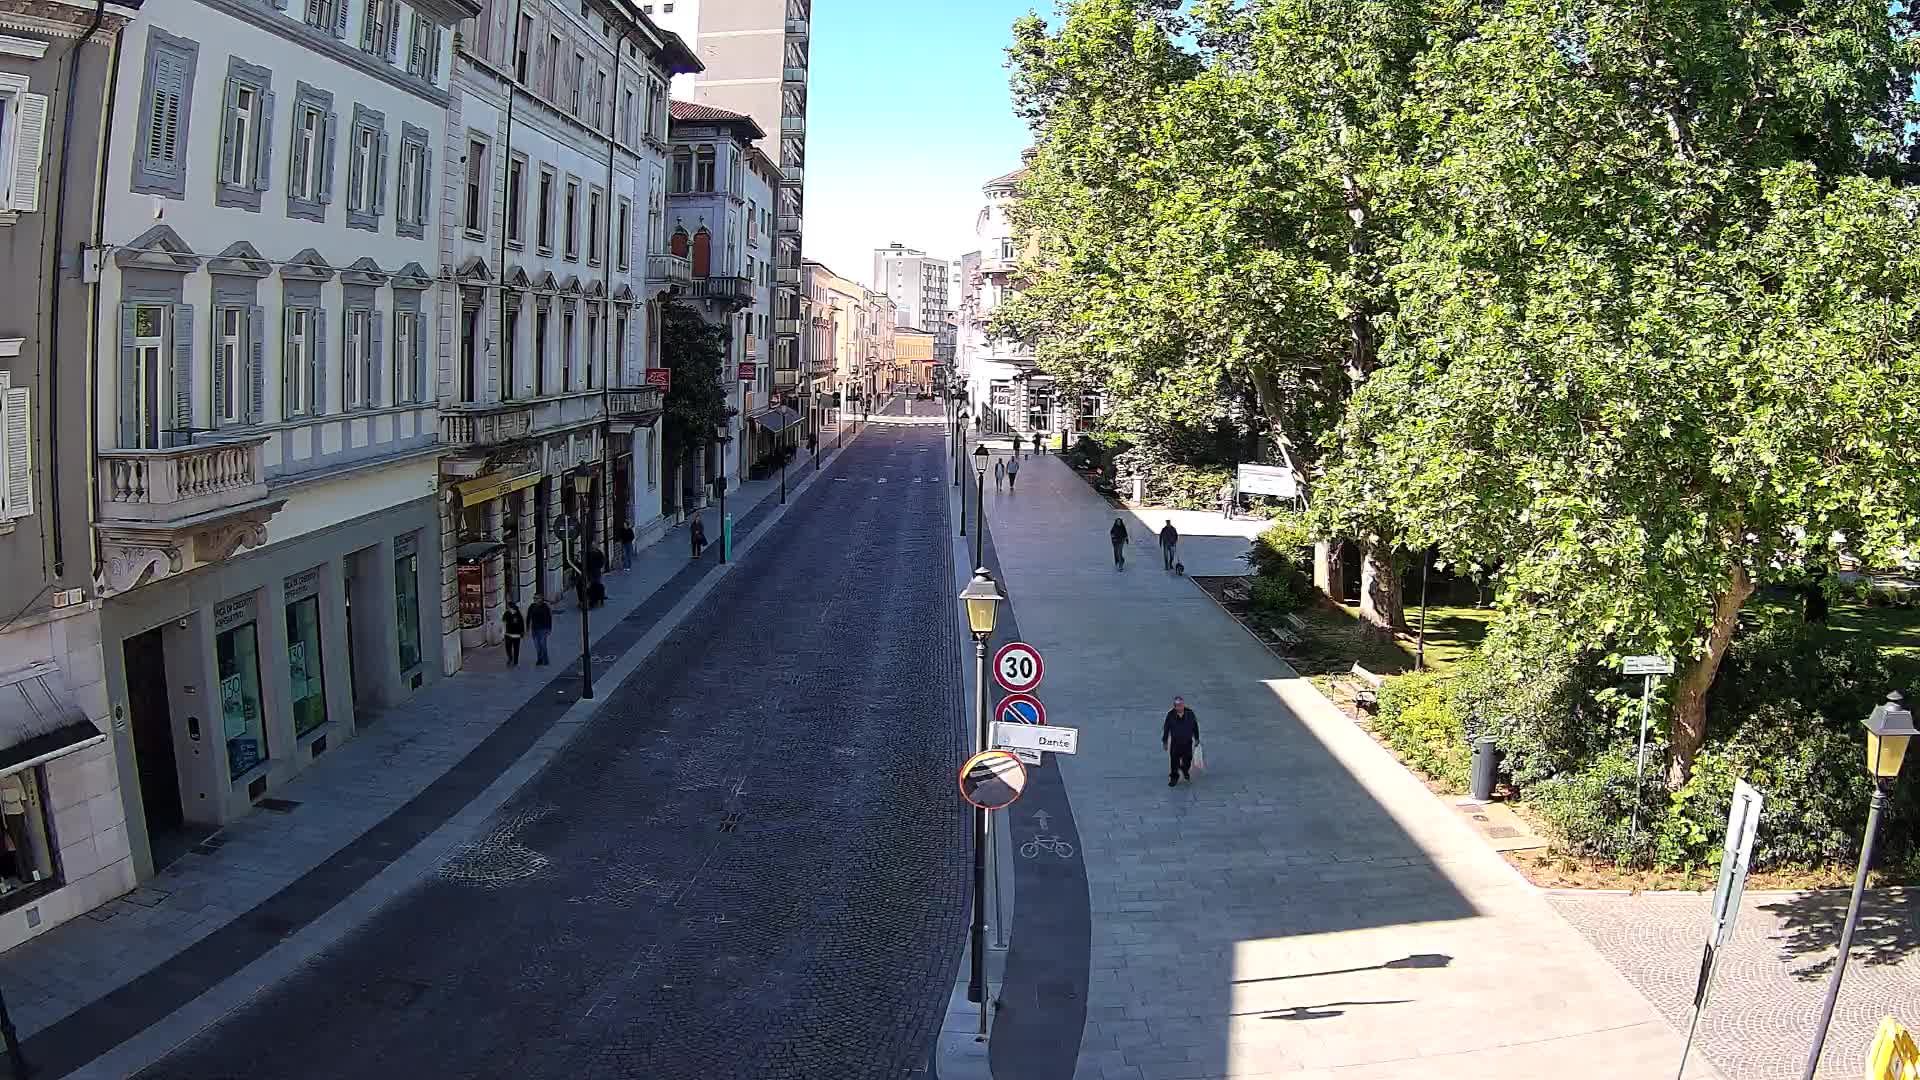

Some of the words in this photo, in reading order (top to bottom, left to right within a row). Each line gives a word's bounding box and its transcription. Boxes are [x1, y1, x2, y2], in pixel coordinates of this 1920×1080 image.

[1005, 656, 1032, 679] 30
[223, 677, 240, 700] 130
[1039, 736, 1070, 748] Dante
